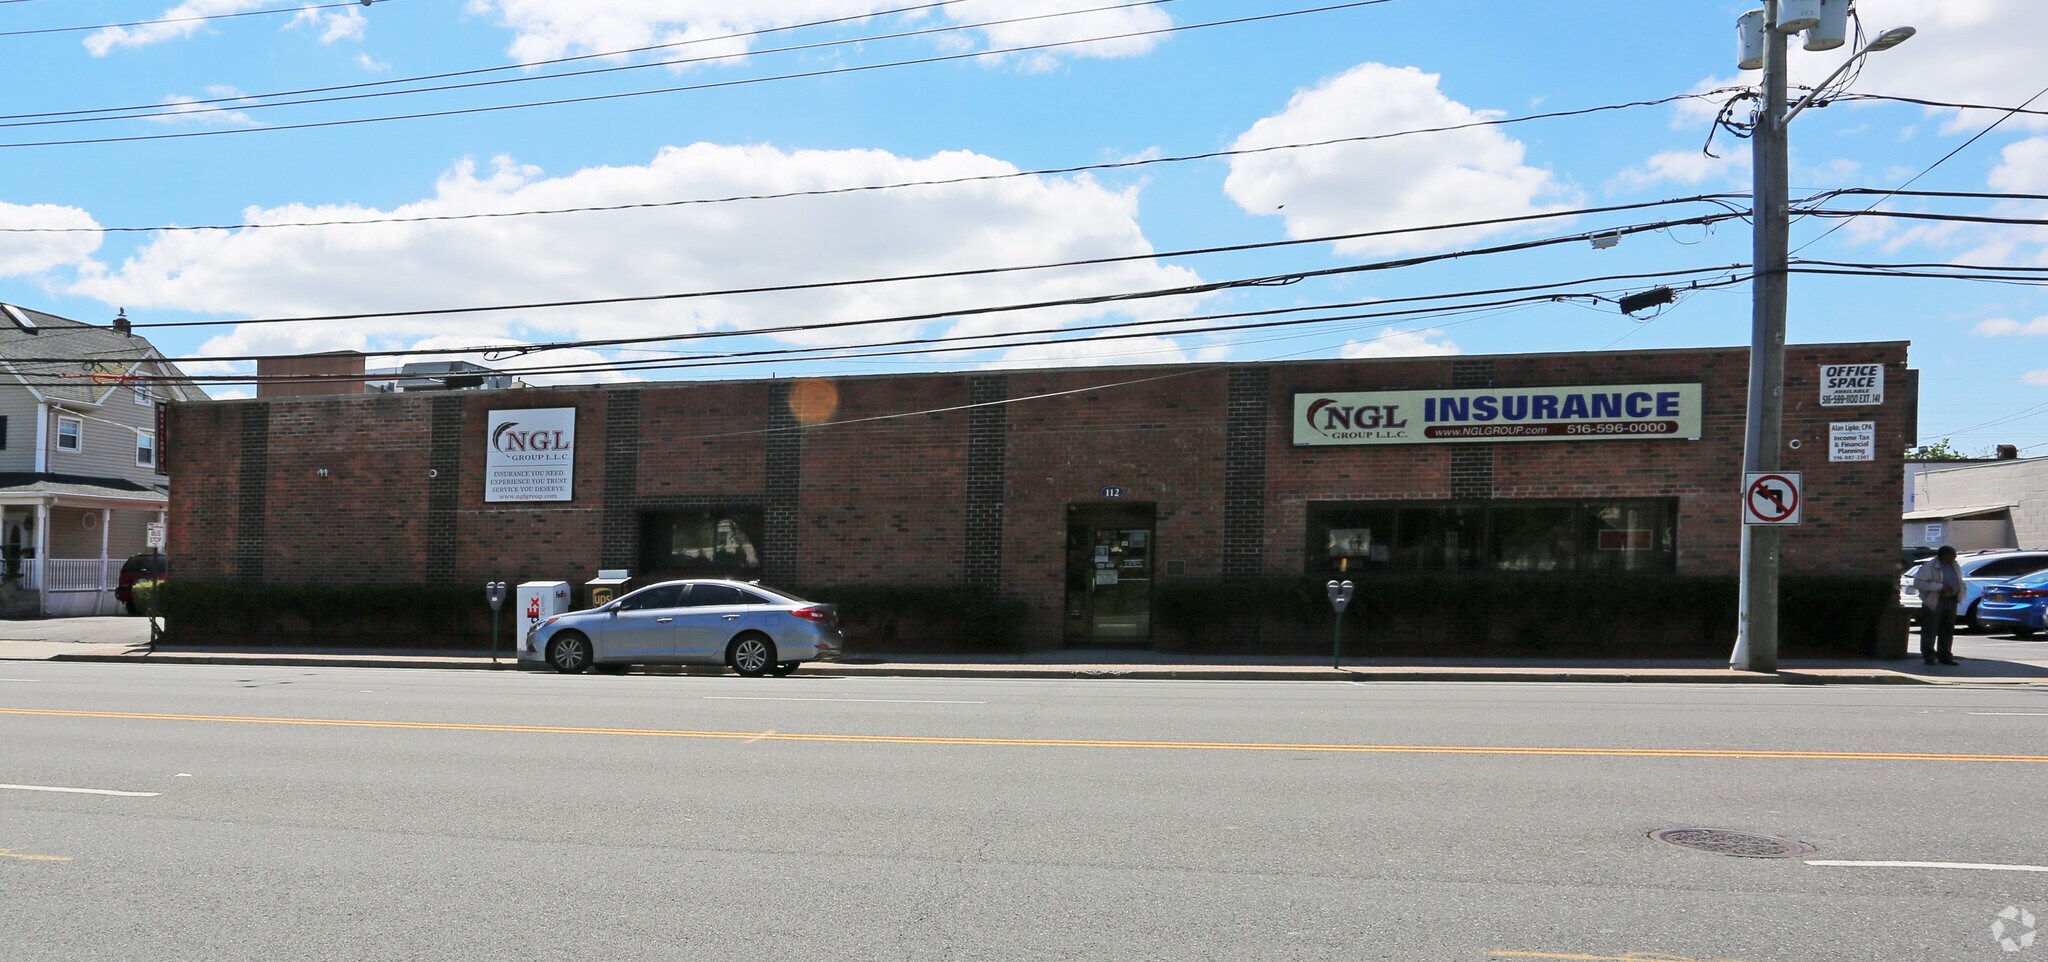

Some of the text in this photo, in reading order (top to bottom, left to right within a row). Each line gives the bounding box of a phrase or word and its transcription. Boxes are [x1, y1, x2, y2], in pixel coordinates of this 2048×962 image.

[1826, 366, 1878, 377] OFFICE
[1828, 377, 1876, 388] SPACE
[1424, 391, 1680, 422] INSURANCE
[1324, 405, 1408, 430] NGL
[1435, 418, 1667, 437] www.NGLGROUP.com 516-596-0000
[504, 430, 570, 452] NGL
[1105, 489, 1120, 497] 112
